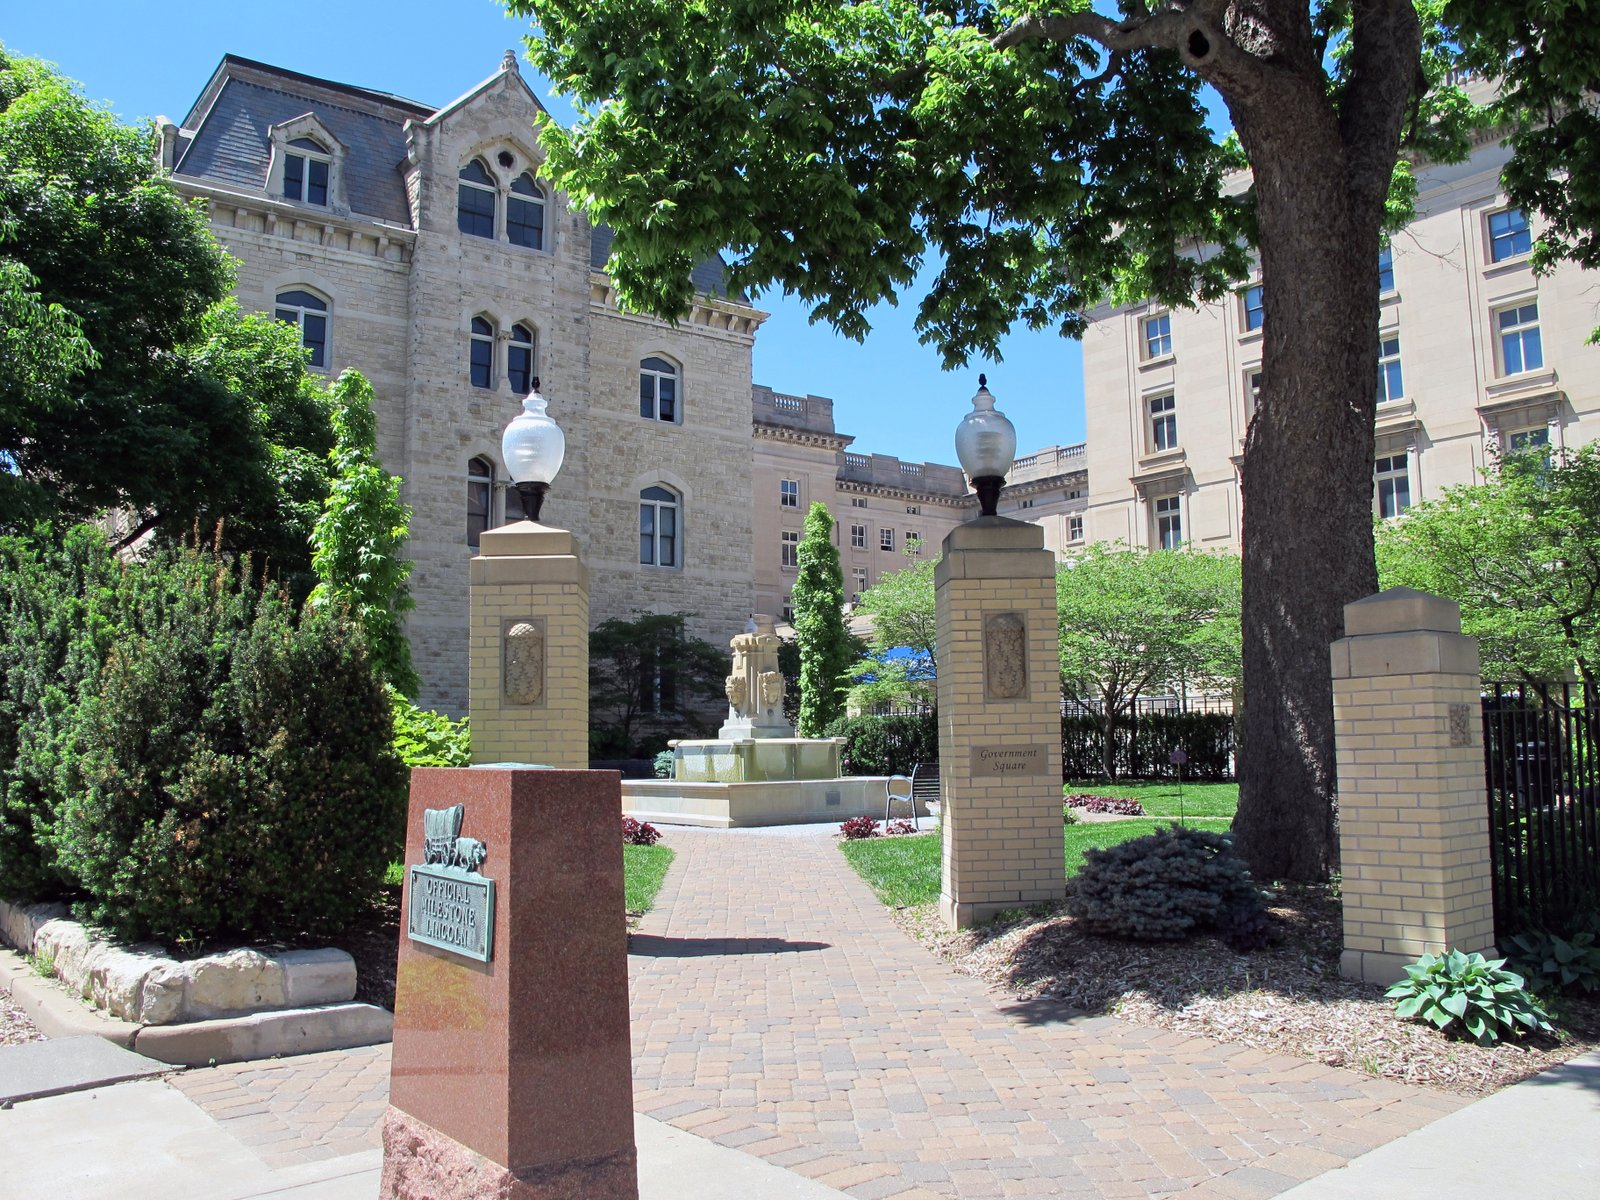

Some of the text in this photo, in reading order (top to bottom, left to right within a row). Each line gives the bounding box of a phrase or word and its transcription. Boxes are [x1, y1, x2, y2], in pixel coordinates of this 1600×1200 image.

[980, 749, 1037, 761] Government
[992, 761, 1026, 773] Square
[426, 879, 471, 904] OFFICIAL
[421, 898, 476, 928] MILESTONE
[427, 919, 468, 947] LINCOLN
